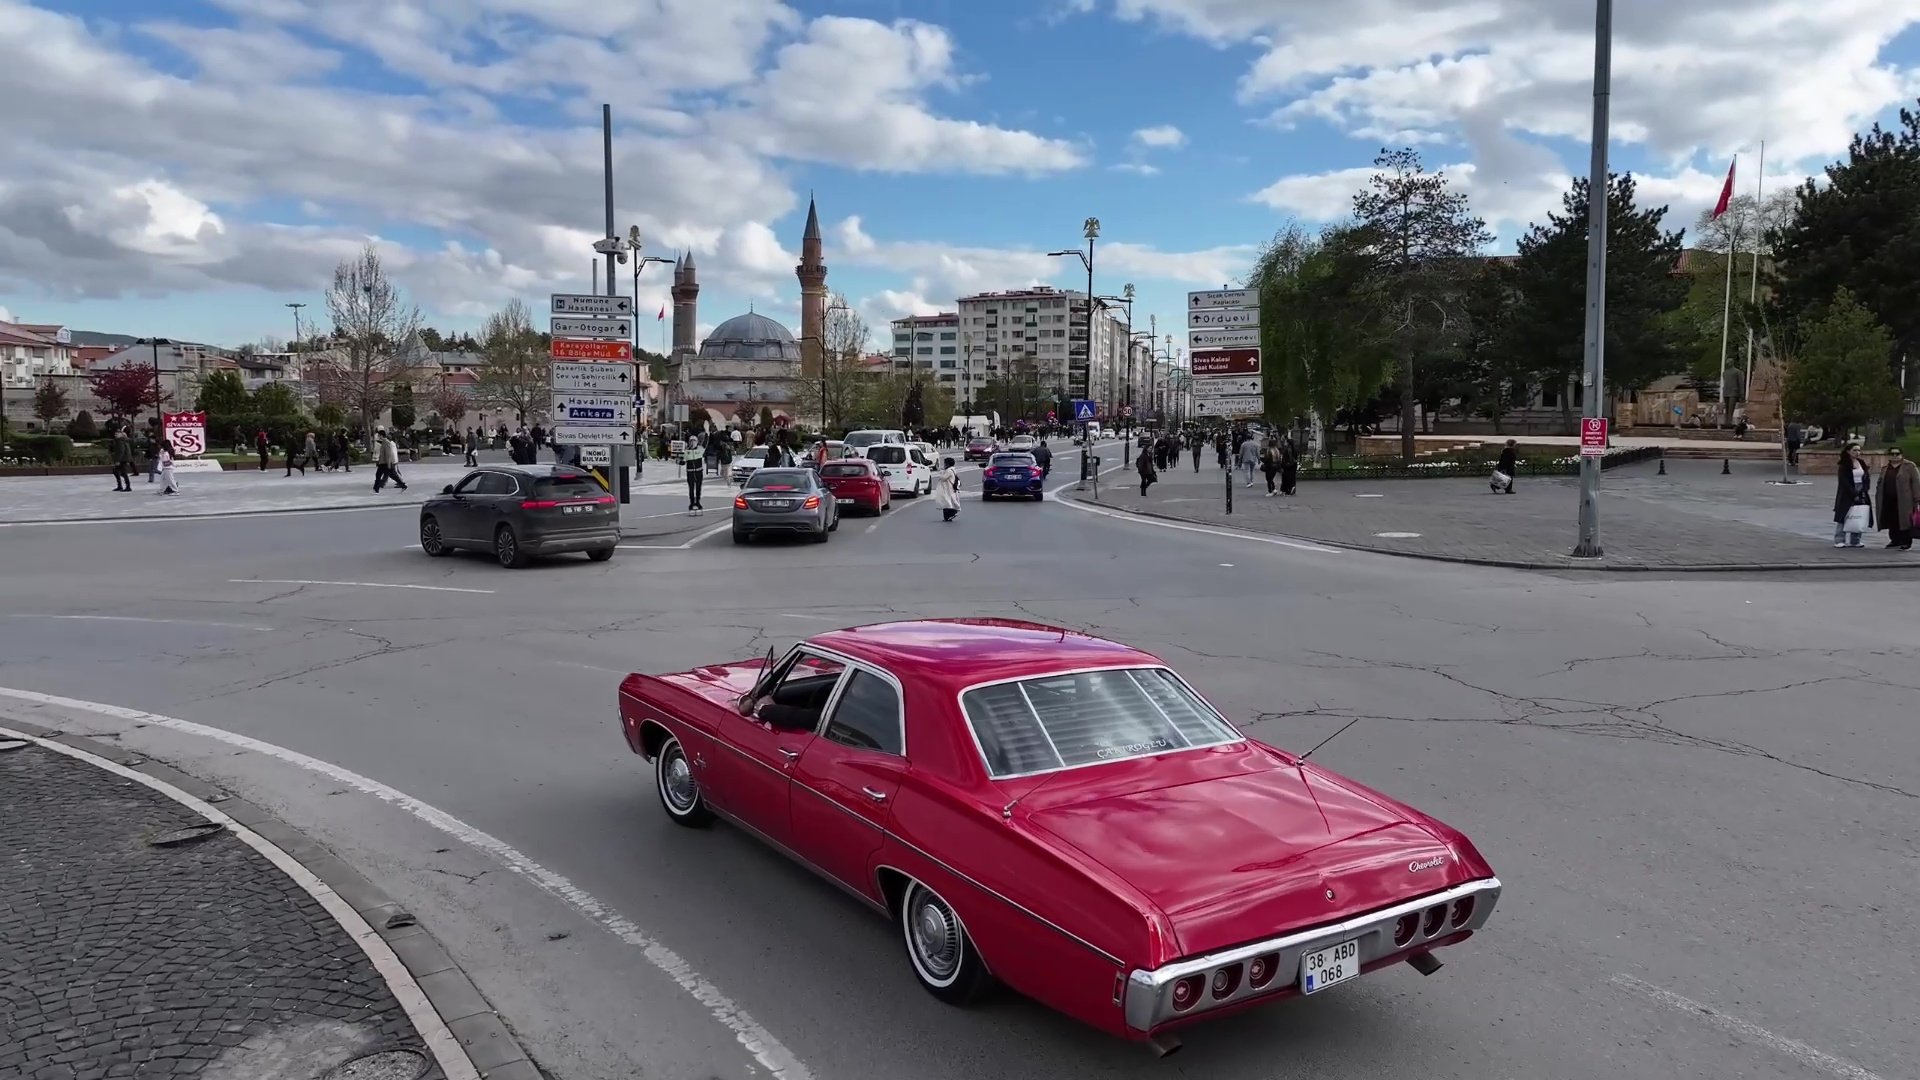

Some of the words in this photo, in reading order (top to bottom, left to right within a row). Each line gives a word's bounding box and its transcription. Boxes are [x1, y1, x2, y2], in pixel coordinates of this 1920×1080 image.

[1203, 313, 1250, 323] Orduevi
[555, 322, 615, 333] Gar-Otogar
[1211, 355, 1231, 363] Kalesi
[568, 397, 630, 406] Havalimanı
[572, 409, 613, 418] Ankara
[1409, 856, 1444, 872] Chevrolet
[1309, 953, 1324, 970] 38
[1334, 942, 1356, 962] ABD
[1320, 964, 1343, 984] 068
